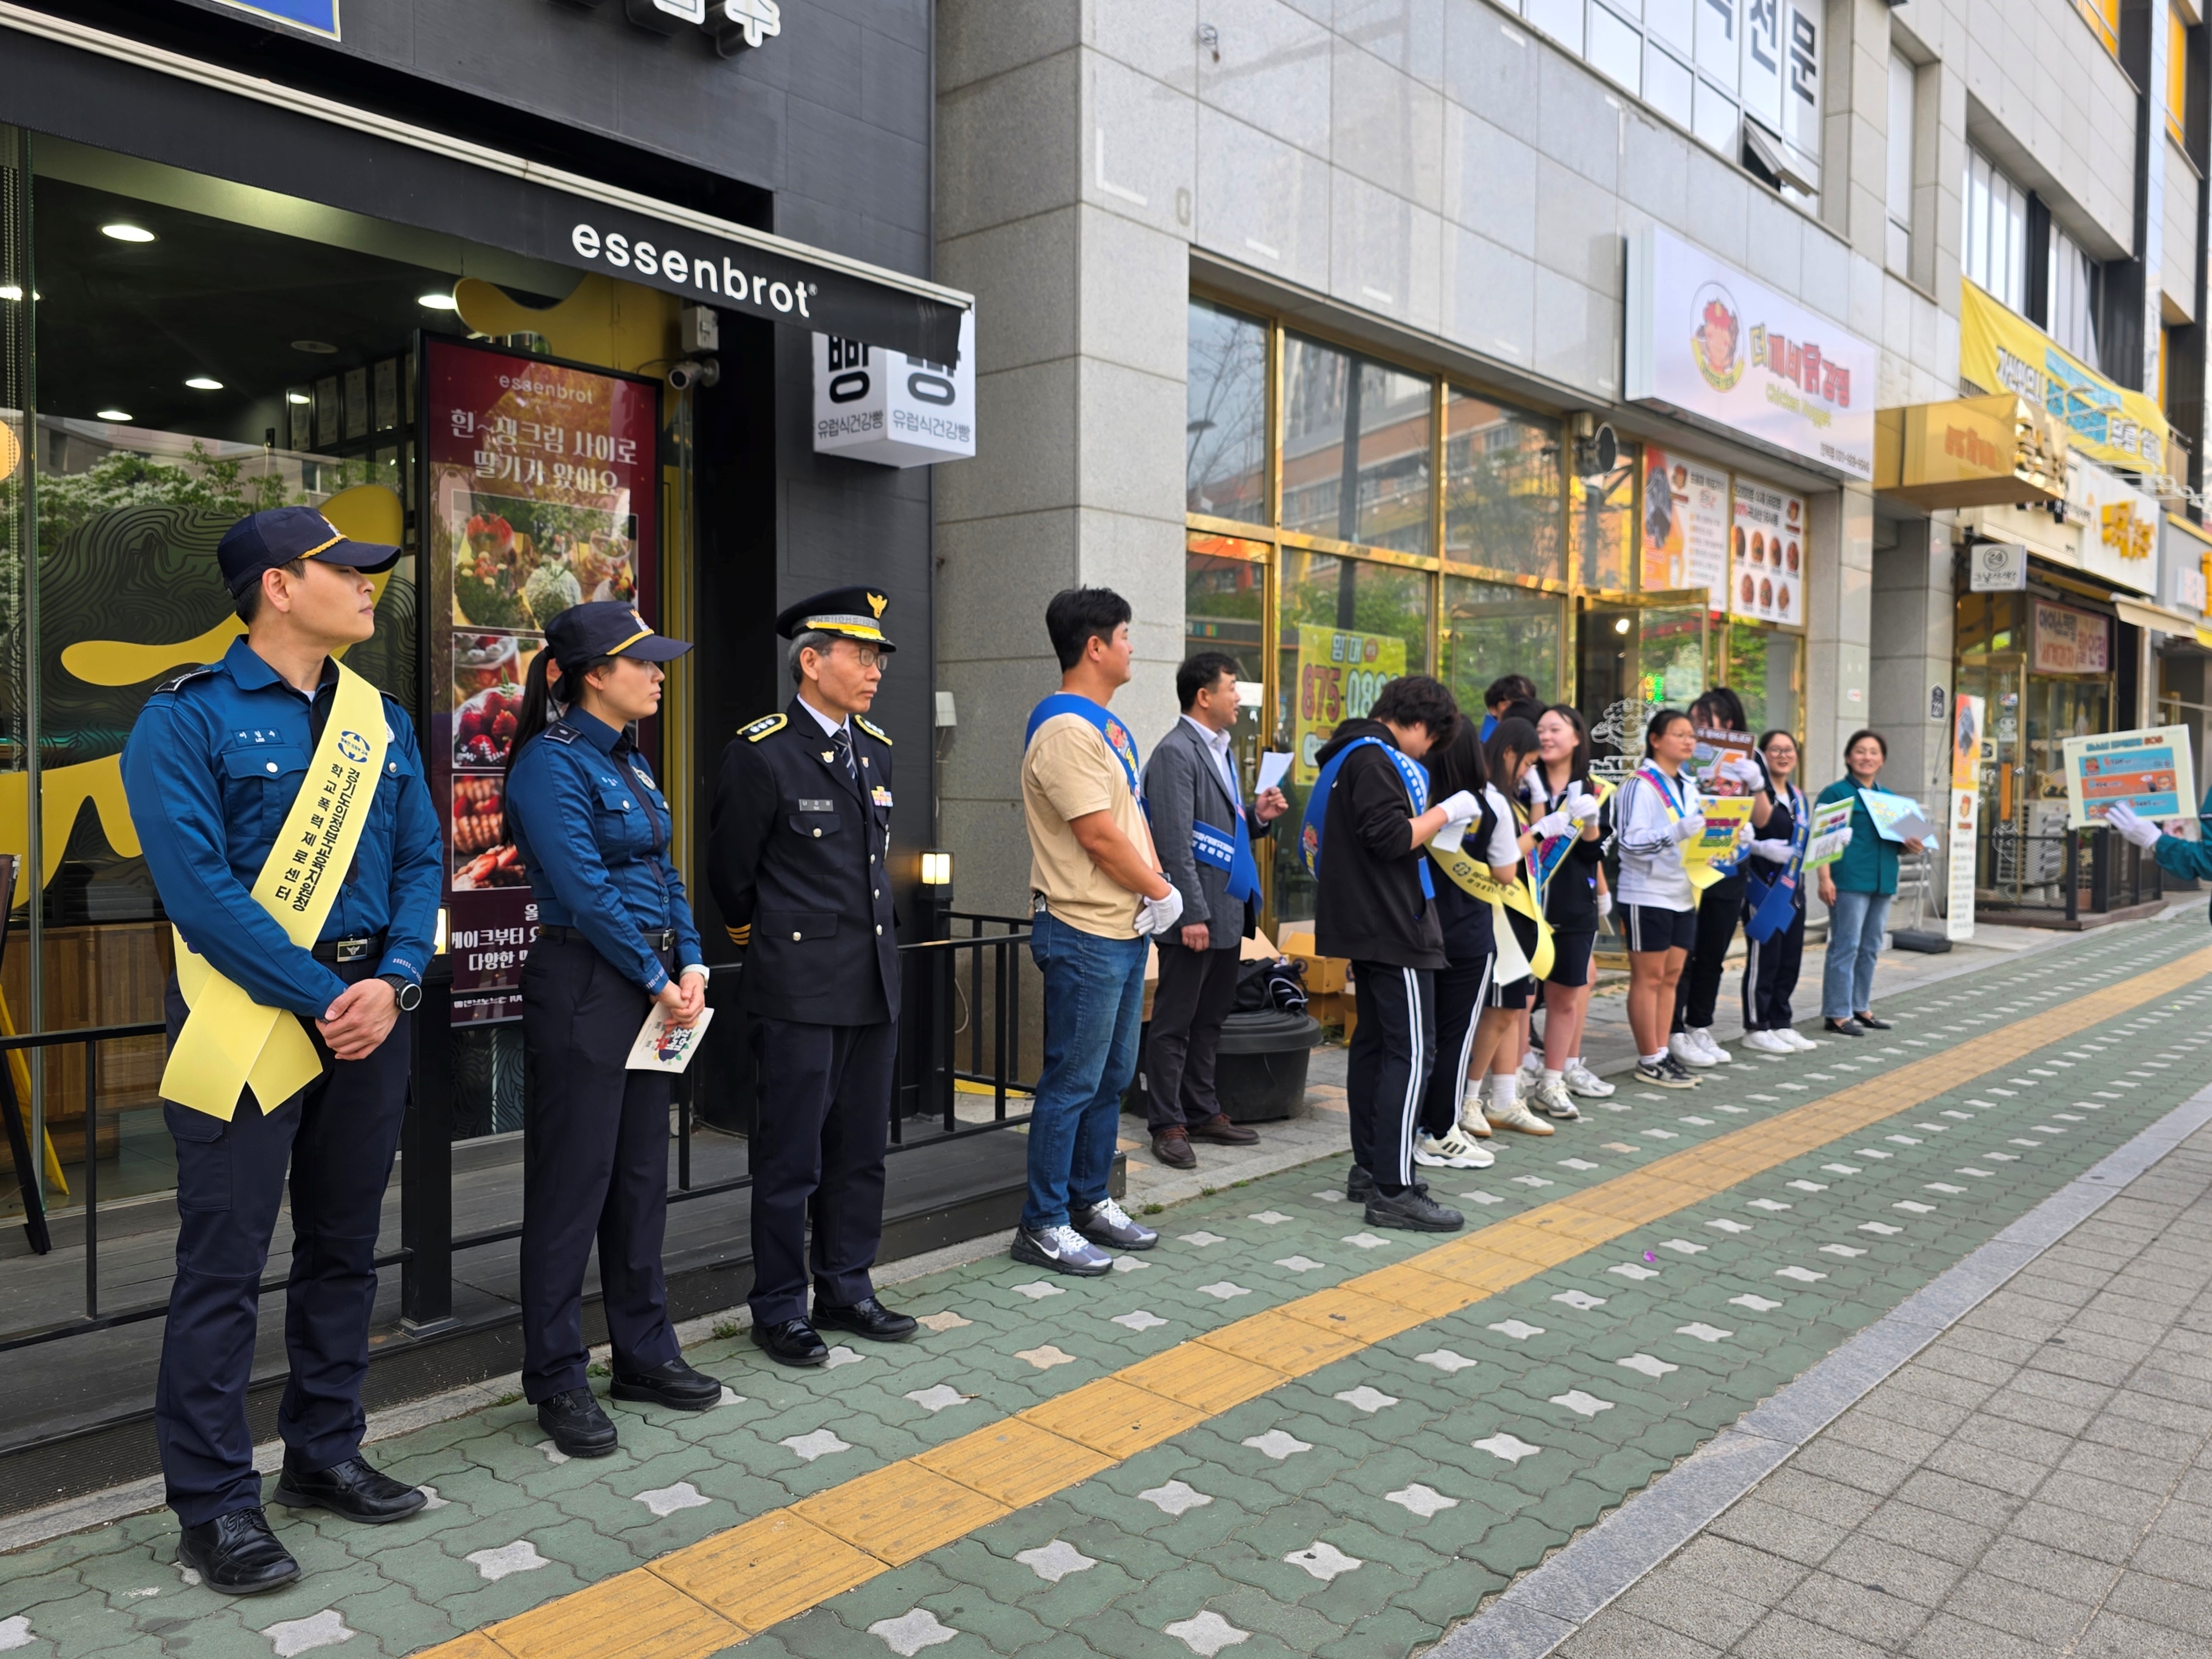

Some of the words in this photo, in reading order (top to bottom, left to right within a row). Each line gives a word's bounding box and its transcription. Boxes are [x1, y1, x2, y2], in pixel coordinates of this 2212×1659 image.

[499, 375, 593, 404] essenbrot
[817, 410, 884, 439] 유럽식건강빵
[893, 409, 971, 443] 유럽식건강빵
[573, 431, 638, 465] 사이로
[474, 450, 546, 486] 딸기가
[1301, 663, 1400, 722] 875-08
[293, 767, 361, 912] 경기도의정부교육지원청
[469, 950, 515, 971] 다양한
